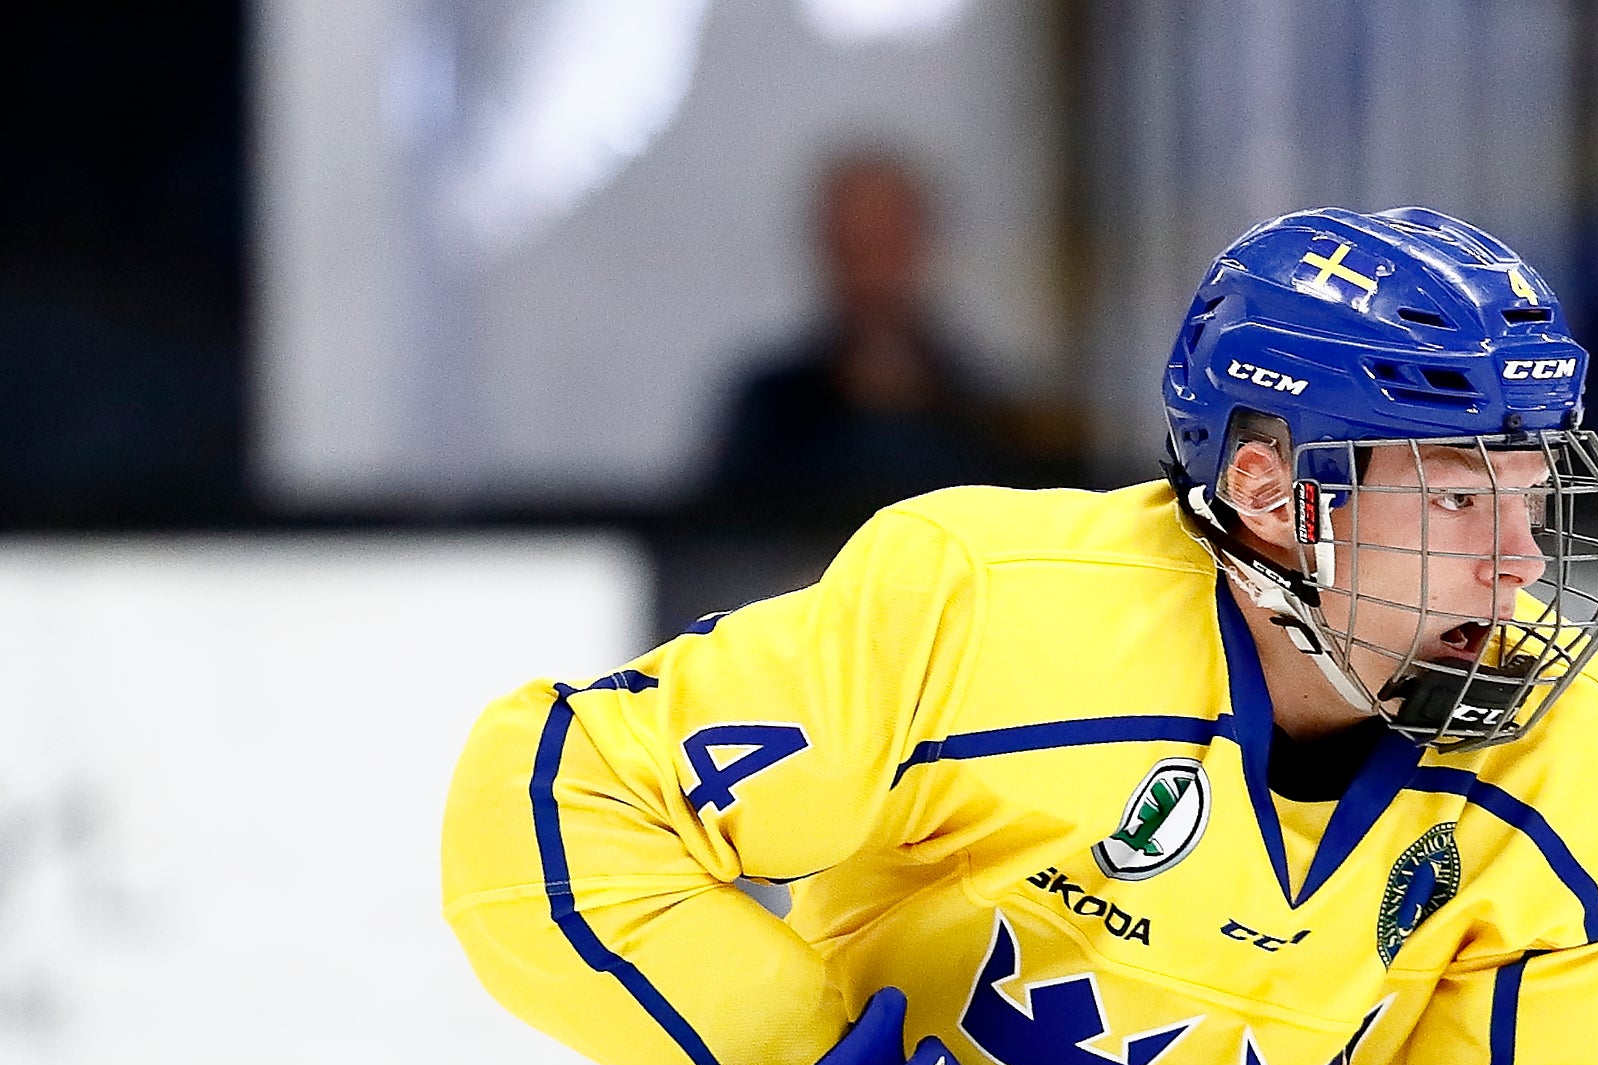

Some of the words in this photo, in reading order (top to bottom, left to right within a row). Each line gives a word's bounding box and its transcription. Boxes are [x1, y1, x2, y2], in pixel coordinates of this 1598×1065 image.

[1227, 358, 1309, 396] CCM
[1502, 358, 1577, 380] CCM
[1252, 559, 1292, 589] CCM
[1452, 703, 1520, 725] CC
[680, 721, 812, 817] 4
[1220, 917, 1312, 953] CC
